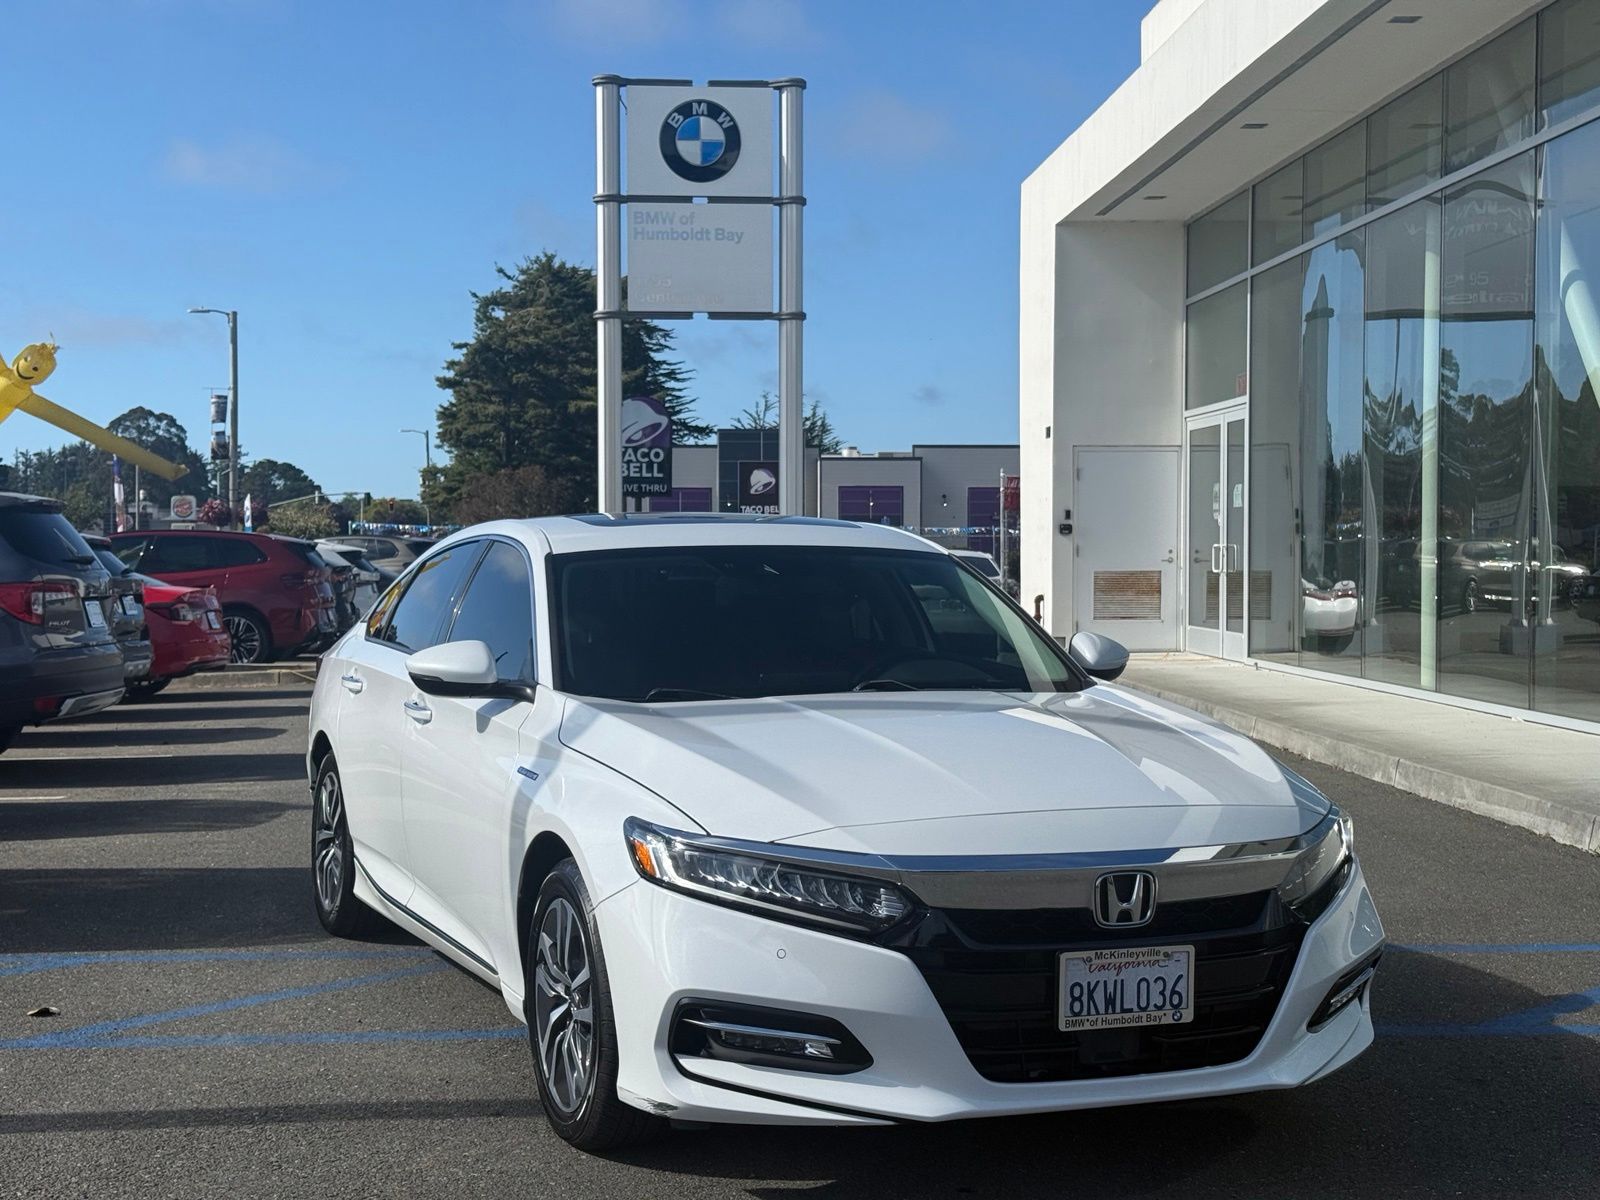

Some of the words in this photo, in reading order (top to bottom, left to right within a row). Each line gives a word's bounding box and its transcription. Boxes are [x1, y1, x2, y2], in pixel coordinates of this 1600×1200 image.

[667, 102, 733, 129] BMW
[633, 211, 675, 225] BMW
[679, 211, 696, 225] of
[633, 228, 711, 242] Humboldt
[715, 229, 744, 244] Bay
[623, 483, 639, 493] IVE
[640, 483, 668, 493] THRU
[764, 505, 780, 515] BEL
[1094, 948, 1161, 961] McKinleyville
[1069, 974, 1184, 1017] 8KWL036
[1101, 1014, 1143, 1026] Humboldt
